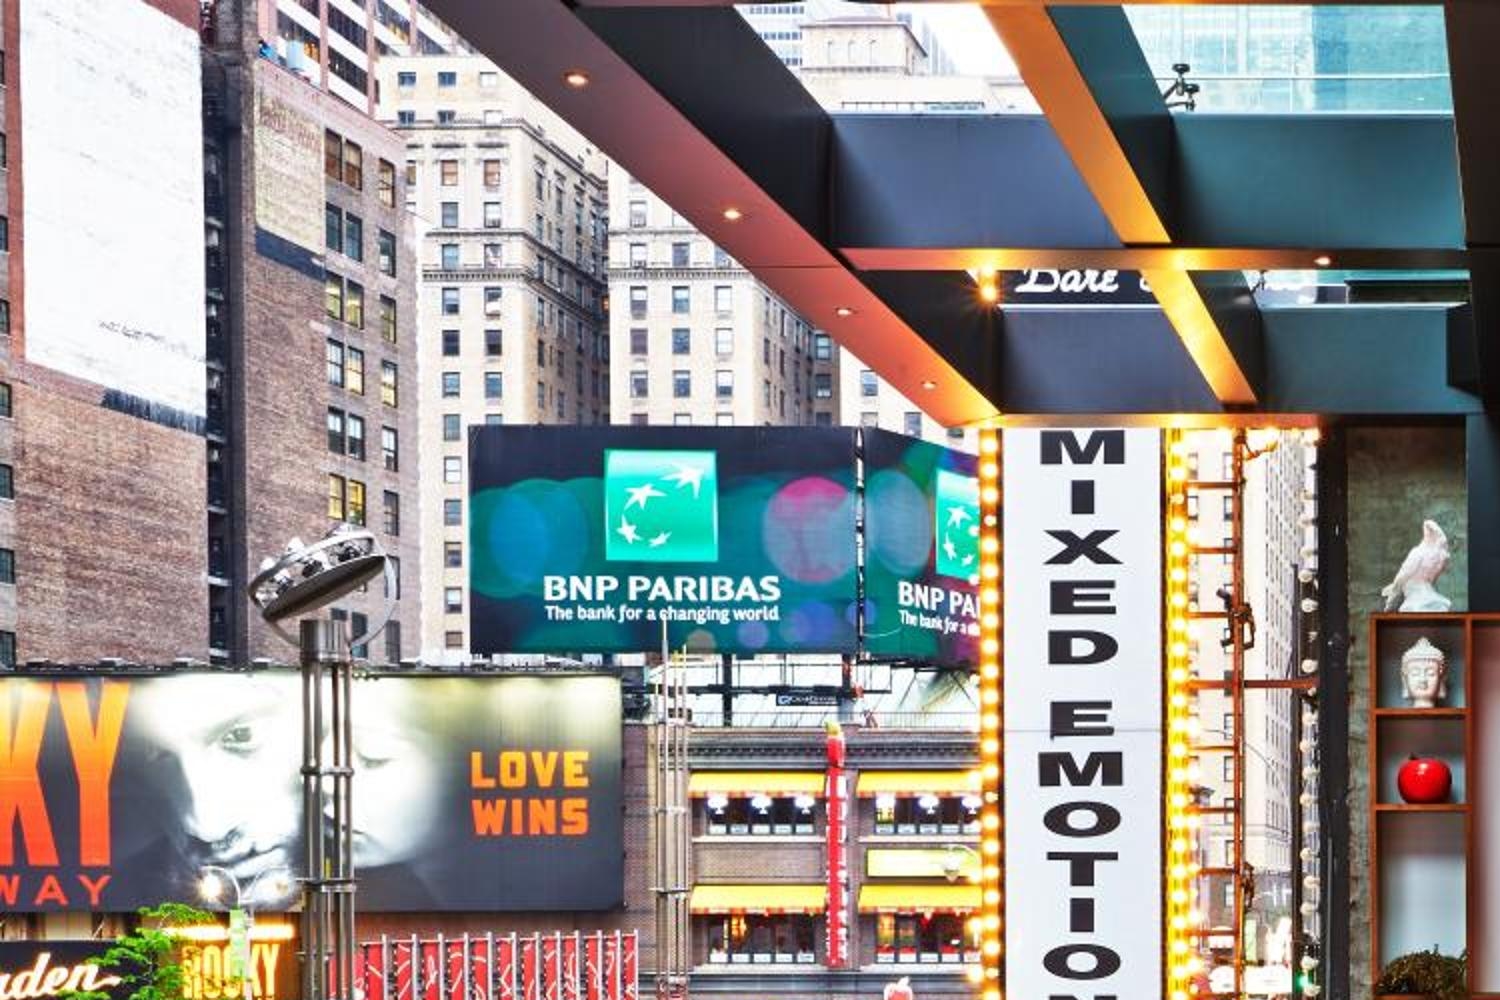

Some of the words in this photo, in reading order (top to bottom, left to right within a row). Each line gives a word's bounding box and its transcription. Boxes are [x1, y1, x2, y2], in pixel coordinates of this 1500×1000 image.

[1040, 430, 1125, 664] MIXED
[543, 575, 619, 601] BNP
[627, 575, 781, 602] PARIBAS
[897, 579, 945, 611] BNP
[545, 605, 573, 621] The
[577, 604, 617, 621] bank
[618, 604, 642, 623] for
[646, 608, 657, 621] a
[659, 605, 731, 624] changing
[733, 605, 780, 621] world
[471, 750, 589, 789] LOVE
[471, 798, 589, 836] WINS
